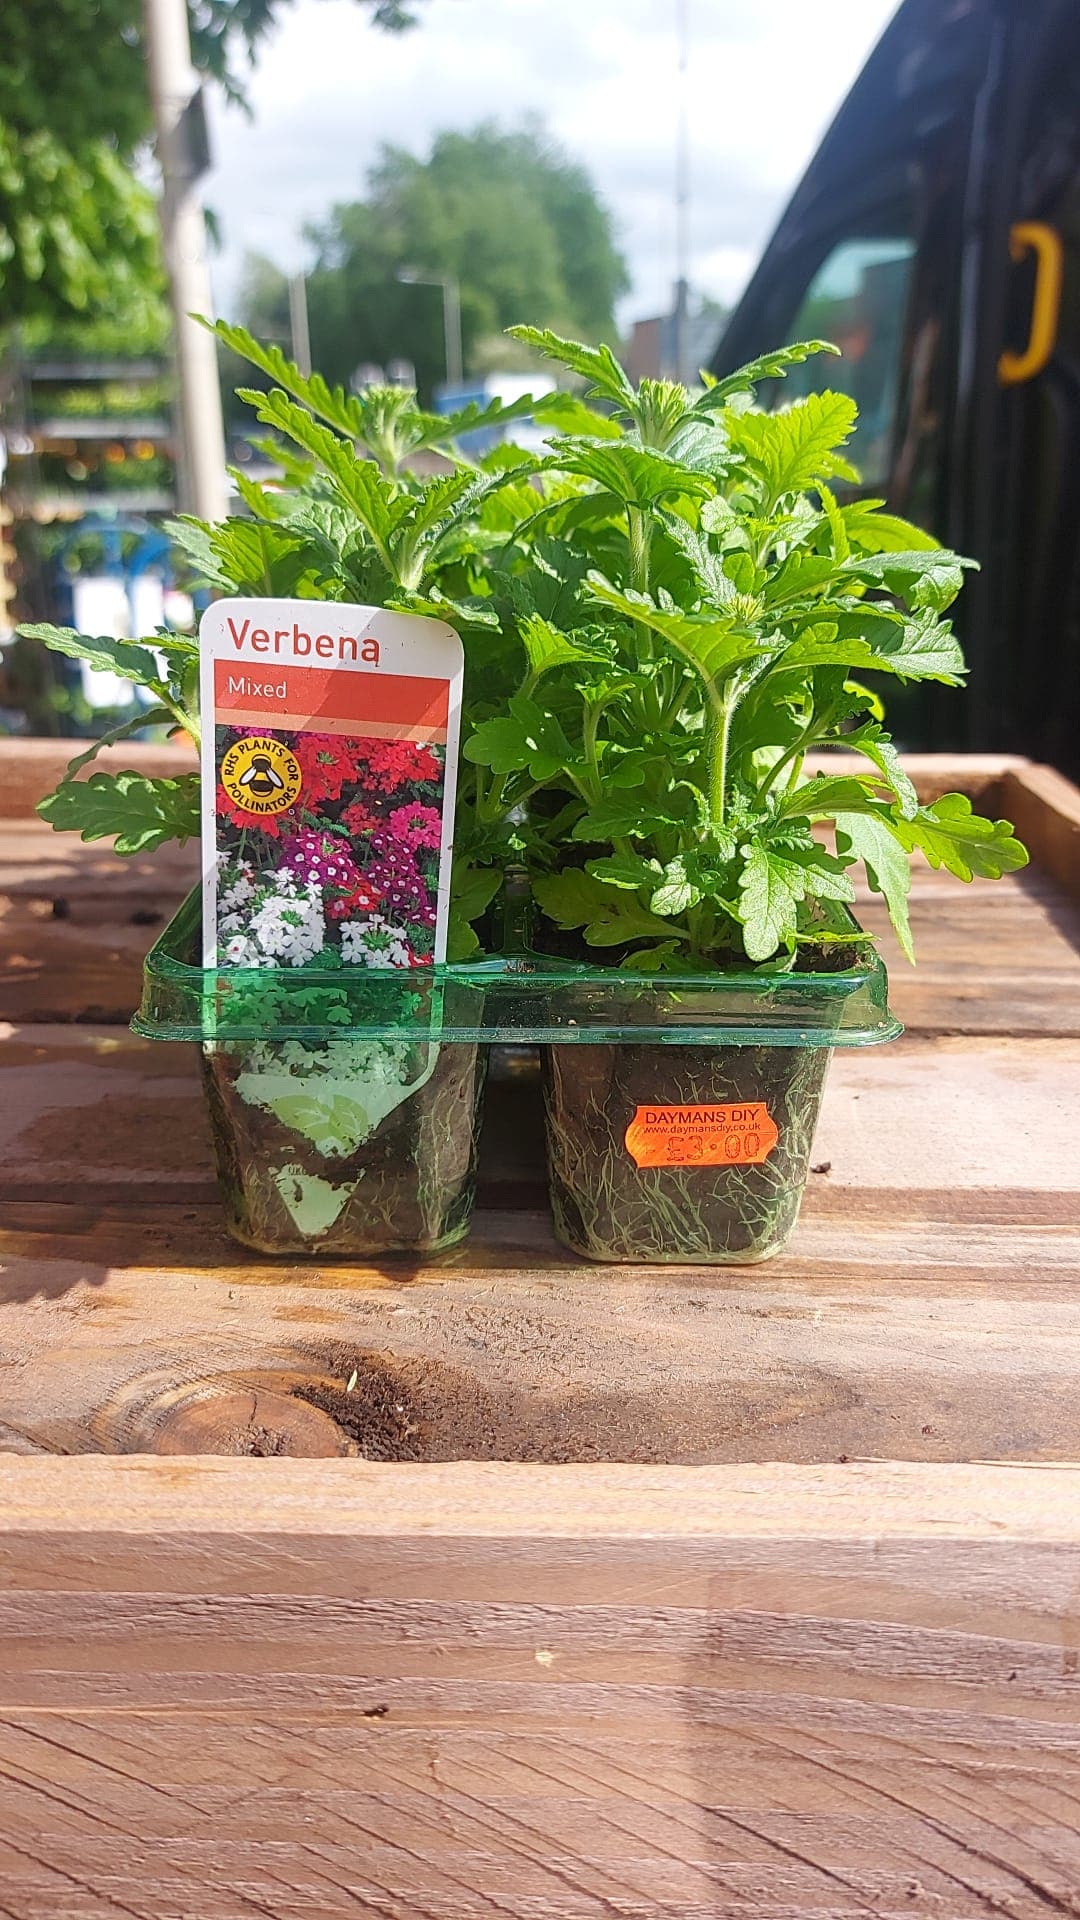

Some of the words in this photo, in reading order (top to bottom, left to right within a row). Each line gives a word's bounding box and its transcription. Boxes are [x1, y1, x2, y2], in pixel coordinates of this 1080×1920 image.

[227, 618, 380, 662] Verbena
[228, 676, 287, 699] Mixed
[225, 753, 239, 776] RHS
[238, 740, 285, 757] PLANTS
[284, 758, 298, 781] FOR
[227, 782, 297, 812] POLLINATORS
[644, 1123, 760, 1134] www.daymansdiy.co.uk
[645, 1111, 726, 1124] DAYMANS
[731, 1109, 760, 1122] DIY
